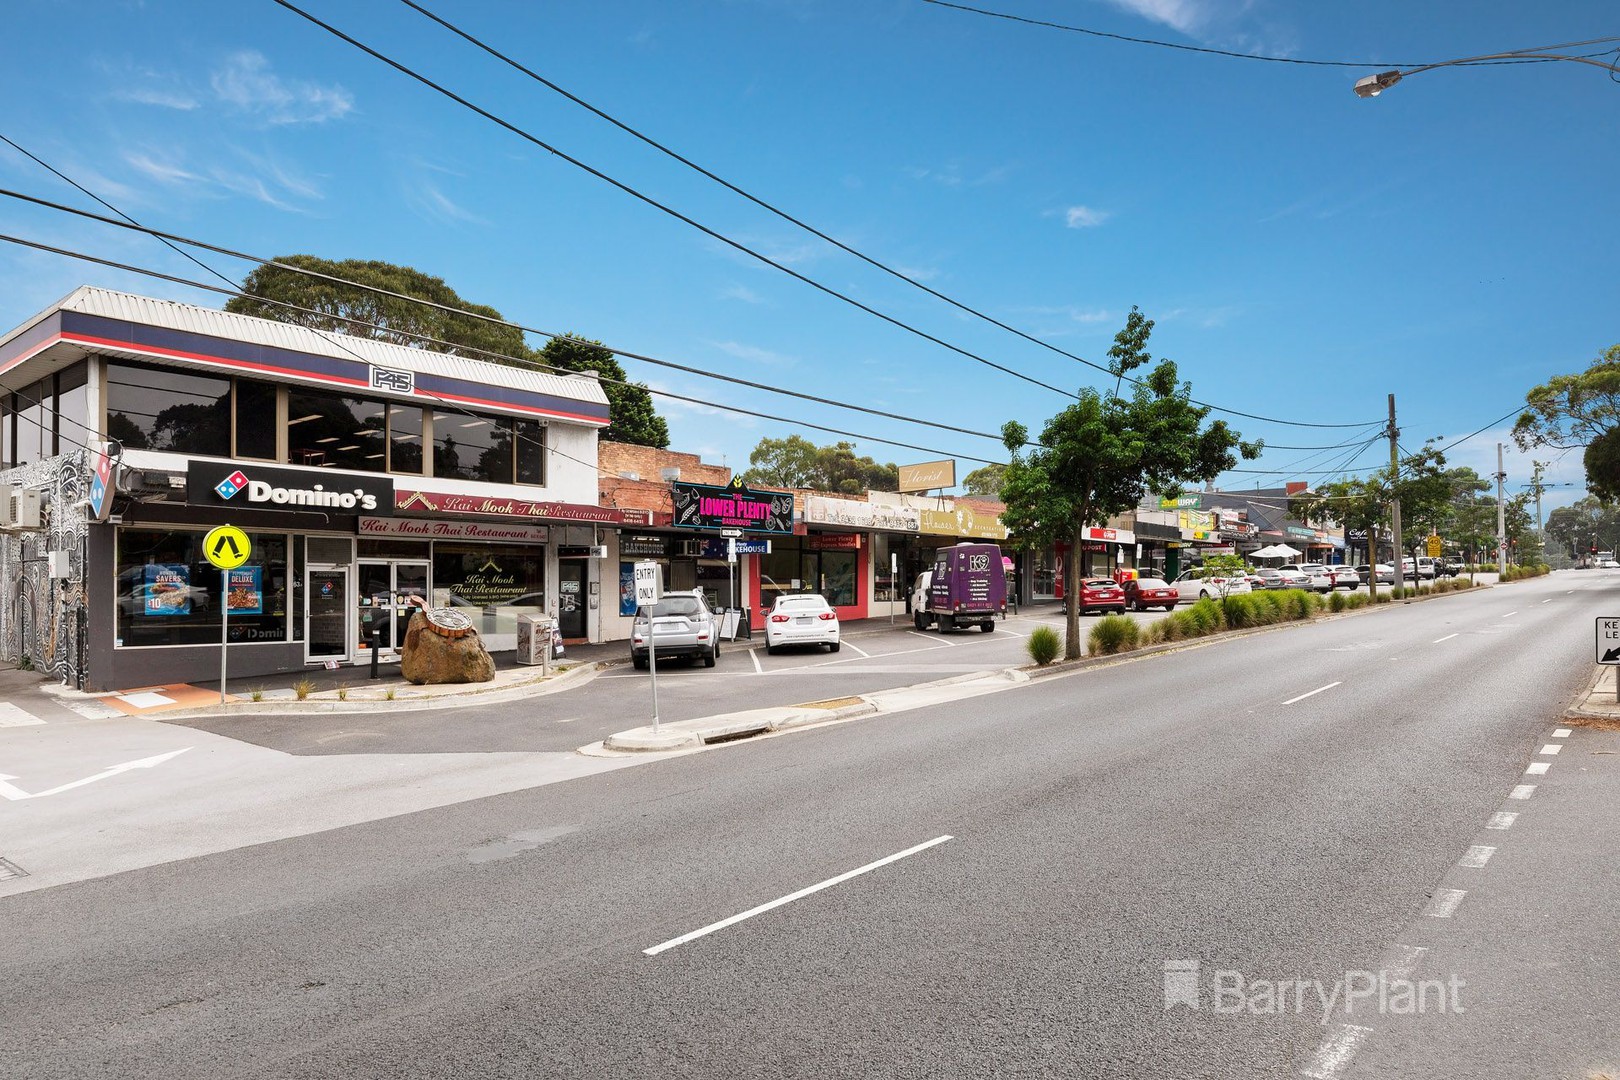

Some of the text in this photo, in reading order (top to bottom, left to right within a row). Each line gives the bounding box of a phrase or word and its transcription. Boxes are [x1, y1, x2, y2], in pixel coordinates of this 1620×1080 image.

[904, 468, 943, 487] Florist
[248, 480, 377, 510] Domino's
[1161, 498, 1198, 507] SUBWAY
[443, 497, 472, 510] Kai
[474, 499, 514, 514] Mook
[517, 503, 548, 517] Thai
[548, 504, 612, 521] Restaurant
[699, 497, 772, 520] LOWER PLENTY
[722, 518, 752, 527] BAKEHOUSE
[360, 519, 389, 532] Kai
[391, 520, 430, 534] Mook
[433, 522, 462, 536] Thai
[464, 525, 528, 539] Restaurant
[625, 543, 664, 554] BAKEHOUSE
[726, 545, 766, 553] BKEHOUSE
[970, 555, 990, 570] K9
[464, 574, 514, 584] Kai Mook
[636, 568, 655, 580] ENTRY
[450, 583, 527, 594] Thai Restaurant
[561, 581, 580, 592] F45
[639, 587, 654, 599] ONLY
[248, 627, 301, 638] Domi's
